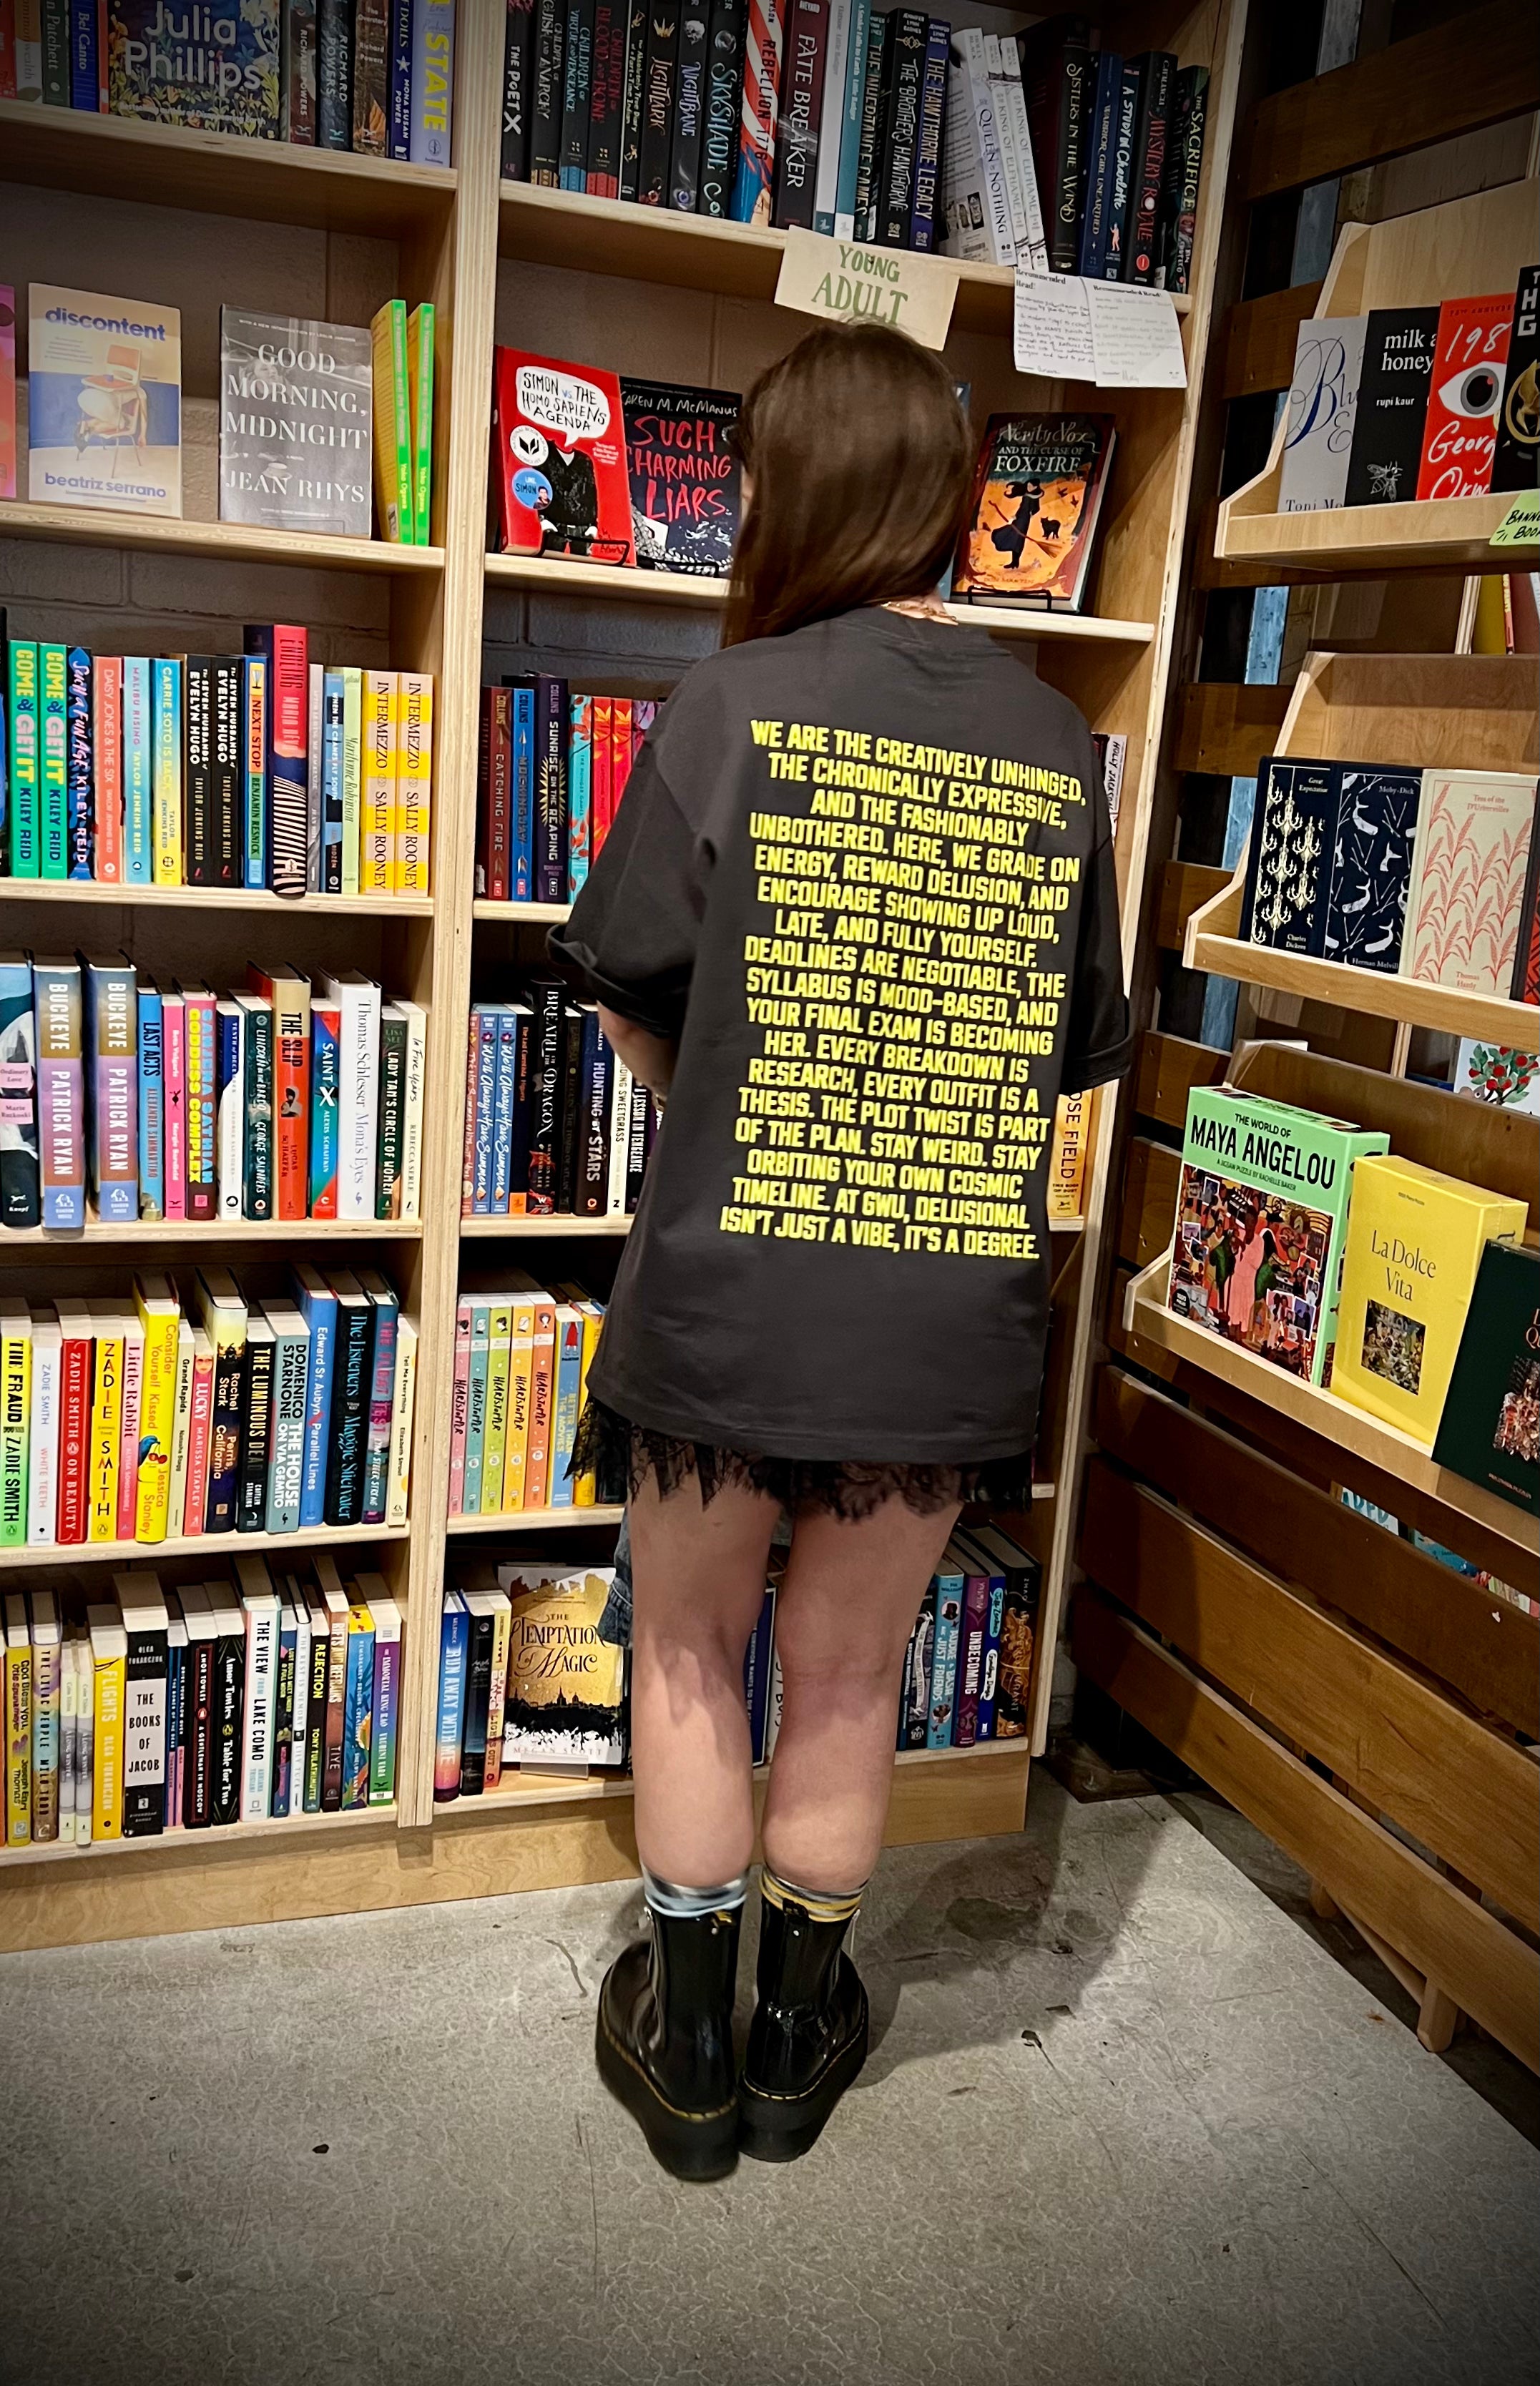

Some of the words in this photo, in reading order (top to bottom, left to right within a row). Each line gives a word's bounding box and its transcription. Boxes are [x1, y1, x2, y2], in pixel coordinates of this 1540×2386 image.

[77, 11, 90, 31] Bel
[144, 1, 237, 44] Julia
[78, 34, 91, 70] Canto
[125, 40, 262, 97] Phillips
[511, 46, 520, 67] THE
[795, 34, 818, 85] FATE
[423, 33, 449, 132] STATE
[928, 57, 945, 87] THE
[507, 71, 520, 111] POET
[1066, 63, 1084, 121] SISTERS
[1122, 86, 1135, 95] A
[504, 112, 522, 135] X
[919, 86, 944, 165] HAWTHORNE
[1068, 124, 1079, 139] IN
[1121, 102, 1133, 136] STUDY
[786, 90, 811, 188] BREAKER
[1066, 144, 1079, 169] THE
[1184, 112, 1204, 210] SACRIFICE
[915, 167, 936, 220] LEGACY
[1114, 150, 1130, 210] Charlotte
[1059, 175, 1078, 222] WIND
[838, 244, 901, 284] YOUNG
[1016, 268, 1066, 285] Recommended
[811, 272, 908, 325] ADULT
[1093, 285, 1142, 297] Recommended
[44, 306, 166, 342] discontent
[1384, 329, 1425, 350] milk
[258, 343, 336, 375] GOOD
[1445, 323, 1513, 363] 198
[1381, 355, 1433, 374] honey
[227, 374, 368, 417] MORNING,
[524, 372, 559, 396] SIMON
[573, 385, 597, 406] THE
[657, 398, 673, 412] M.
[1376, 396, 1393, 408] rupi
[1395, 396, 1415, 406] kaur
[522, 391, 550, 411] HOMO
[553, 398, 607, 425] SAPIENS
[533, 406, 591, 431] AGENDA
[226, 411, 368, 449] MIDNIGHT
[632, 416, 716, 453] SUCH
[1427, 421, 1496, 475] Georg
[994, 455, 1080, 472] FOXFIRE
[44, 472, 104, 491] beatriz
[106, 481, 167, 499] serrano
[225, 471, 288, 496] JEAN
[298, 480, 365, 504] RHYS
[646, 479, 726, 522] LIARS
[1286, 499, 1316, 512] Toni
[16, 649, 35, 697] COME
[16, 699, 34, 712] &
[190, 671, 200, 722] EVELYN
[250, 699, 262, 734] NEXT
[376, 682, 389, 769] INTERMEZZO
[16, 714, 34, 757] GET
[190, 726, 200, 765] HUGO
[251, 735, 262, 768] STOP
[549, 721, 559, 772] SUNRISE
[16, 757, 34, 783] IT
[750, 720, 784, 748] WE
[786, 723, 830, 753] ARE
[833, 729, 872, 760] THE
[875, 737, 988, 781] CREATIVELY
[991, 758, 1086, 806] UNHINGED,
[551, 776, 556, 787] ON
[767, 752, 809, 782] THE
[812, 757, 945, 804] CHRONICALLY
[948, 781, 1067, 830] EXPRESSIVE,
[1378, 785, 1415, 795] Moby-Dick
[19, 787, 31, 825] KILEY
[375, 791, 387, 833] SALLY
[810, 788, 856, 818] AND
[860, 795, 898, 825] THE
[901, 802, 1029, 847] FASHIONABLY
[19, 829, 31, 860] REID
[548, 807, 558, 860] REAPING
[750, 812, 889, 855] UNBOTHERED.
[893, 831, 947, 870] HERE,
[952, 842, 983, 871] WE
[986, 848, 1046, 882] GRADE
[1050, 857, 1080, 882] ON
[373, 835, 386, 889] ROONEY
[755, 844, 838, 883] ENERGY,
[842, 854, 924, 891] REWARD
[926, 868, 1025, 911] DELUSION,
[1027, 885, 1069, 910] AND
[757, 875, 882, 914] ENCOURAGE
[884, 891, 971, 929] SHOWING
[974, 905, 1004, 932] UP
[1007, 910, 1059, 944] LOUD,
[775, 908, 829, 943] LATE,
[833, 915, 879, 943] AND
[881, 921, 936, 953] FULLY
[939, 931, 1037, 968] YOURSELF.
[49, 983, 70, 1050] BUCKEYE
[280, 1012, 303, 1036] THE
[281, 1039, 303, 1067] SLIP
[322, 1043, 334, 1083] SAINT
[387, 1052, 399, 1073] LADY
[51, 1071, 72, 1132] PATRICK
[319, 1086, 335, 1106] X
[385, 1076, 399, 1107] TAN'S
[592, 1062, 605, 1116] HUNTING
[384, 1110, 398, 1143] CIRCLE
[1235, 1112, 1250, 1127] THE
[1251, 1117, 1279, 1135] WORLD
[1280, 1127, 1292, 1139] OF
[53, 1140, 73, 1175] RYAN
[384, 1145, 396, 1161] OF
[587, 1136, 604, 1182] STARS
[1060, 1130, 1079, 1179] FIELD
[1190, 1114, 1239, 1159] MAYA
[1242, 1132, 1335, 1190] ANGELOU
[382, 1164, 396, 1195] WOMEN
[1371, 1229, 1388, 1258] La
[1391, 1239, 1437, 1279] Dolce
[1385, 1266, 1413, 1302] Vita
[9, 1340, 24, 1370] THE
[317, 1327, 328, 1360] Edward
[280, 1345, 293, 1419] STARNONE
[291, 1345, 307, 1419] DOMENICO
[315, 1364, 325, 1383] St.
[8, 1374, 24, 1423] FRAUD
[310, 1384, 324, 1415] Aubyn
[288, 1422, 303, 1450] THE
[310, 1423, 321, 1464] Parallel
[5, 1437, 21, 1475] ZADIE
[285, 1455, 302, 1508] HOUSE
[308, 1466, 319, 1491] Lines
[4, 1478, 19, 1522] SMITH
[510, 1616, 608, 1647] TEMPTATION
[313, 1644, 326, 1699] REJECTION
[444, 1646, 462, 1675] RUN
[965, 1631, 982, 1695] UNBECOMING
[137, 1693, 155, 1706] THE
[443, 1677, 461, 1709] AWAY
[129, 1715, 161, 1729] BOOKS
[441, 1715, 458, 1744] WITH
[139, 1737, 150, 1750] OF
[439, 1747, 456, 1765] ME
[128, 1759, 160, 1772] JACOB
